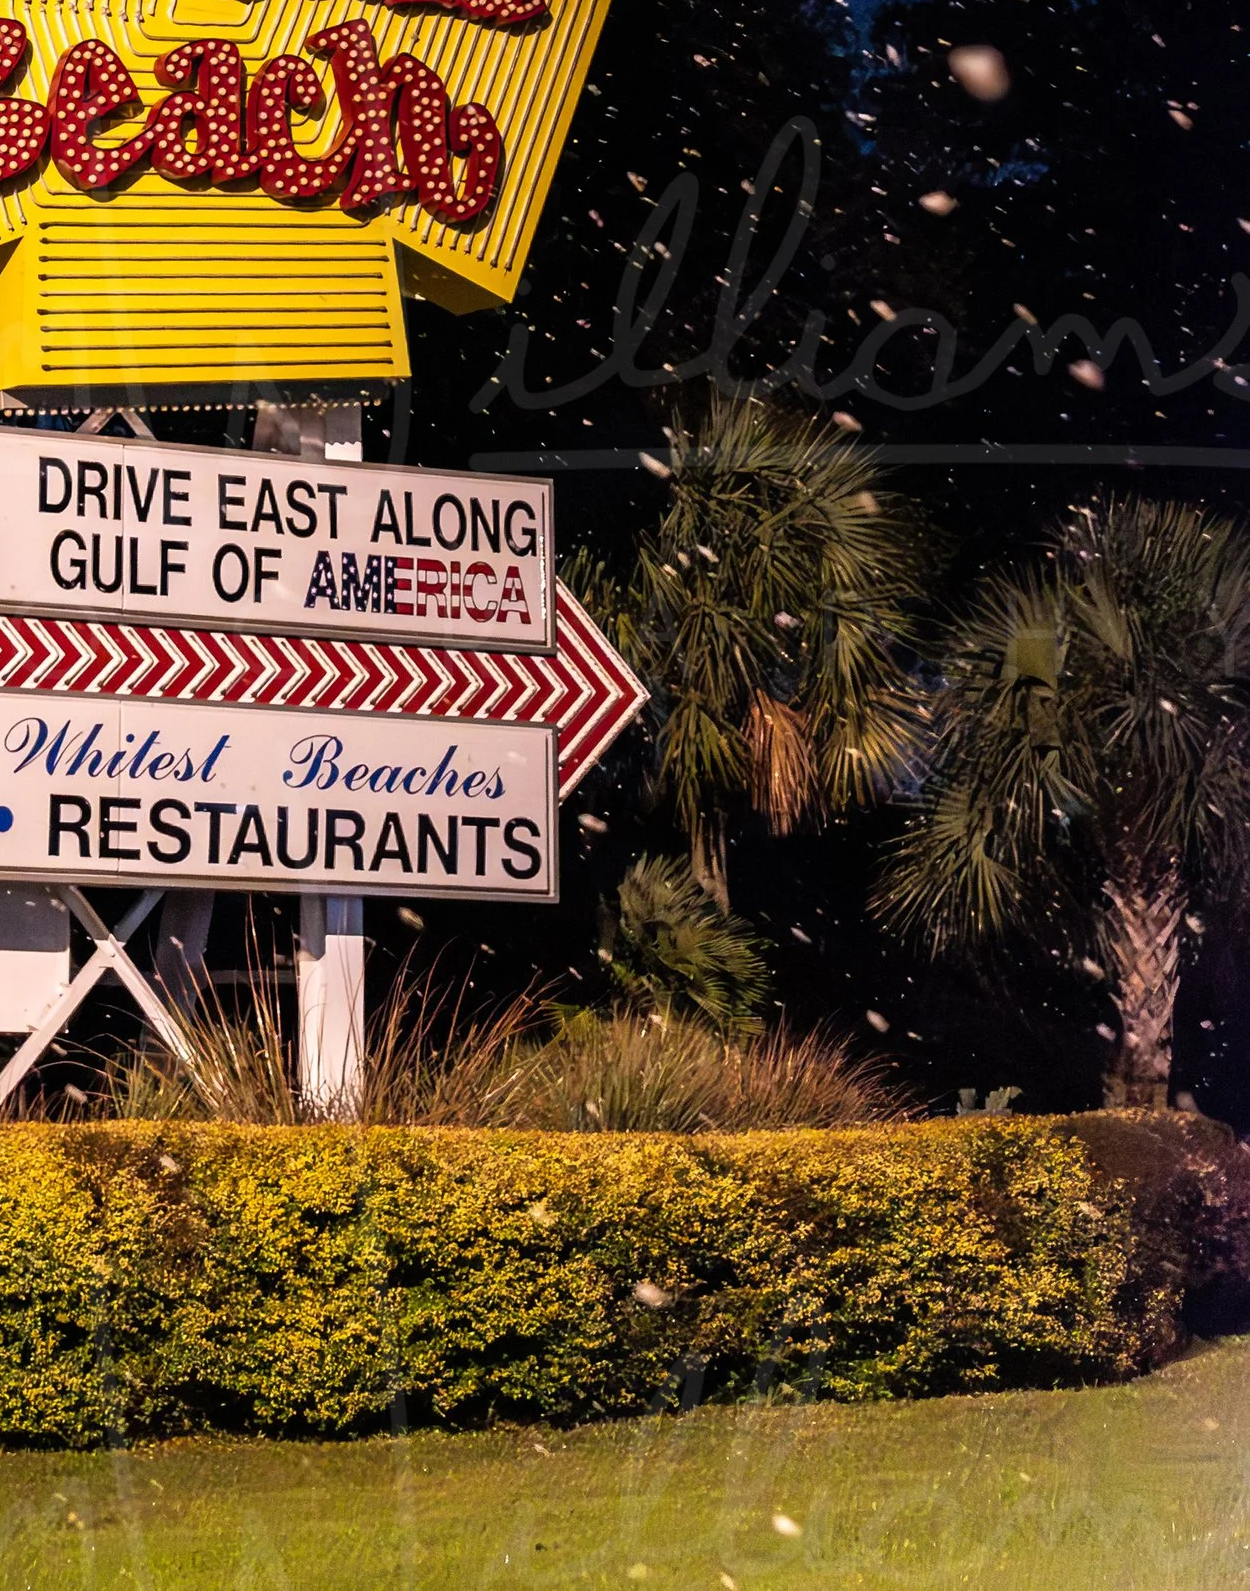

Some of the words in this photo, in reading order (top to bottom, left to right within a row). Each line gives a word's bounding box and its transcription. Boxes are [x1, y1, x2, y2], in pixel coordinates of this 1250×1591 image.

[39, 456, 192, 528] DRIVE
[218, 474, 348, 539] EAST
[370, 489, 538, 557] ALONG
[50, 529, 186, 603] GULF
[212, 543, 282, 604] OF
[303, 549, 531, 626] AMERICA
[3, 716, 232, 783] Whitest
[282, 733, 506, 800] Beaches
[46, 794, 542, 881] RESTAURANTS
